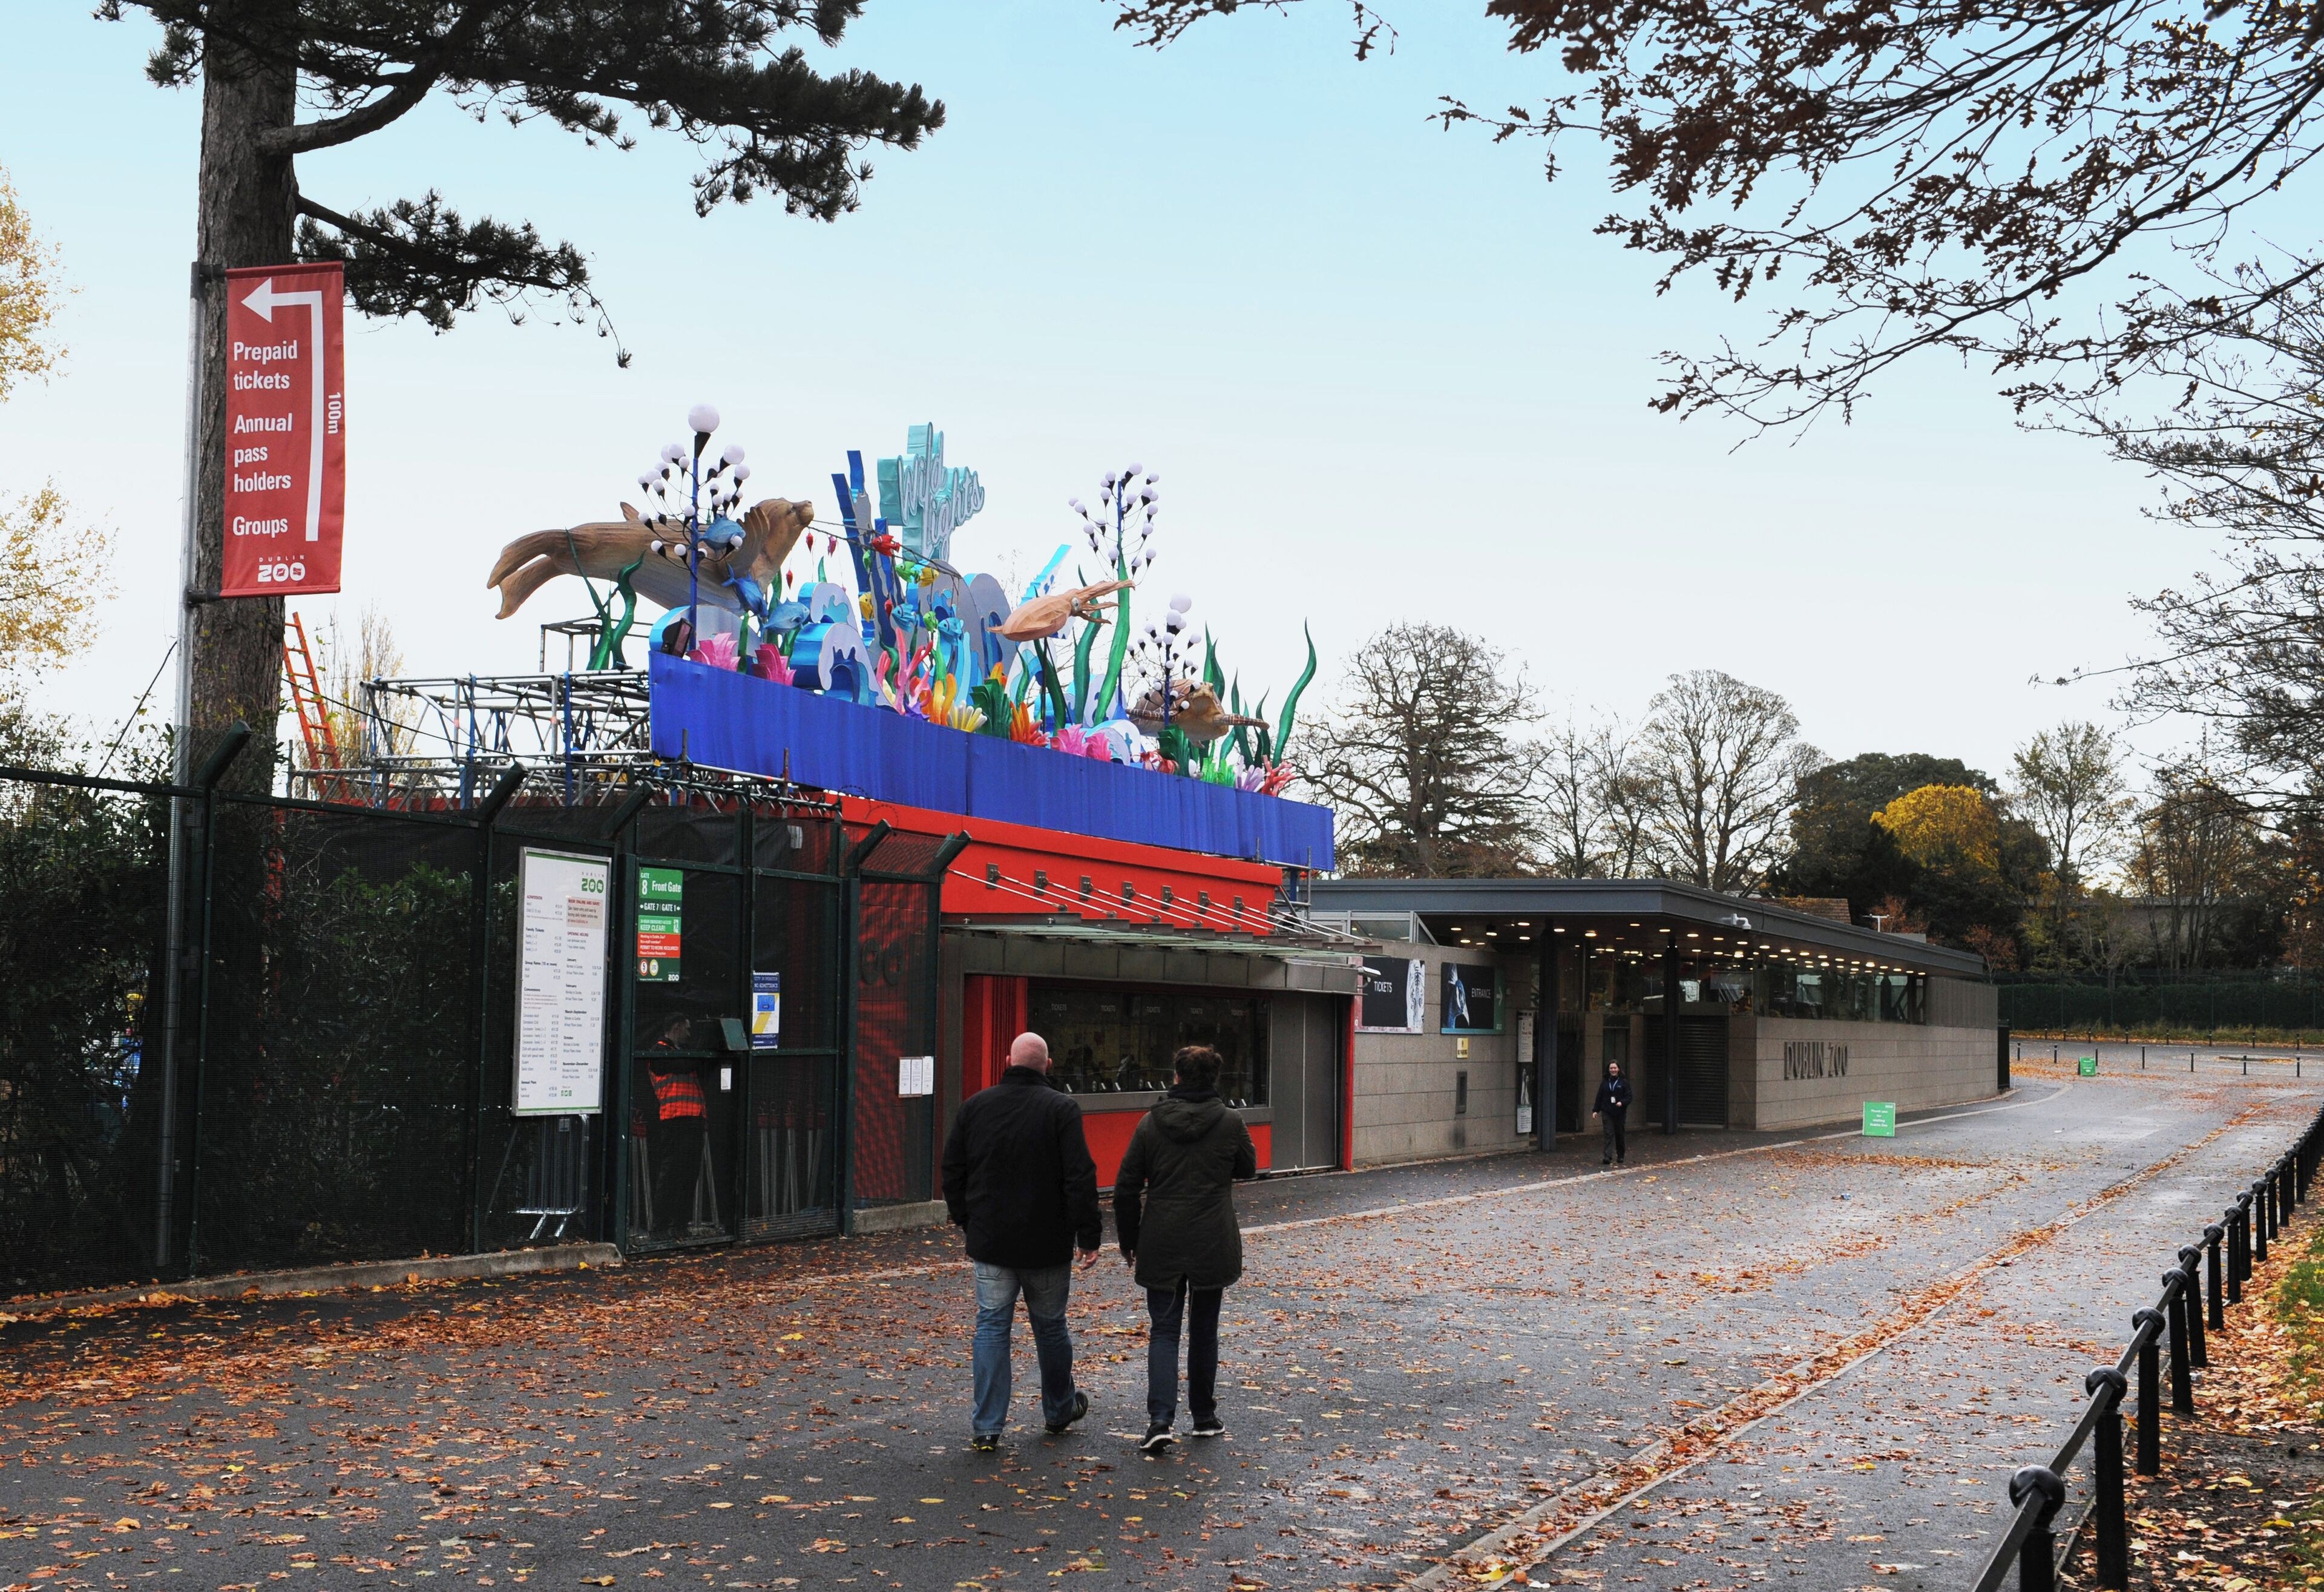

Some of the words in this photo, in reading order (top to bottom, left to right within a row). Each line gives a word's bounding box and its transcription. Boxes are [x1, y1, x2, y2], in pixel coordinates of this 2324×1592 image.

[234, 340, 298, 364] Prepaid
[234, 370, 290, 390] tickets
[234, 413, 293, 434] Annual
[327, 392, 341, 435] 100m
[234, 445, 268, 468] pass
[234, 472, 292, 493] holders
[232, 516, 288, 538] Groups
[258, 562, 306, 582] ZOO
[581, 878, 604, 893] ZOO
[642, 879, 648, 895] 8
[652, 880, 668, 892] Front
[668, 881, 681, 893] Gate
[644, 903, 656, 911] GATE
[1374, 981, 1392, 993] TICKETS
[1471, 987, 1492, 999] ENTRANCE
[1784, 1041, 1824, 1081] DUBLIN
[1828, 1042, 1848, 1077] ZOO
